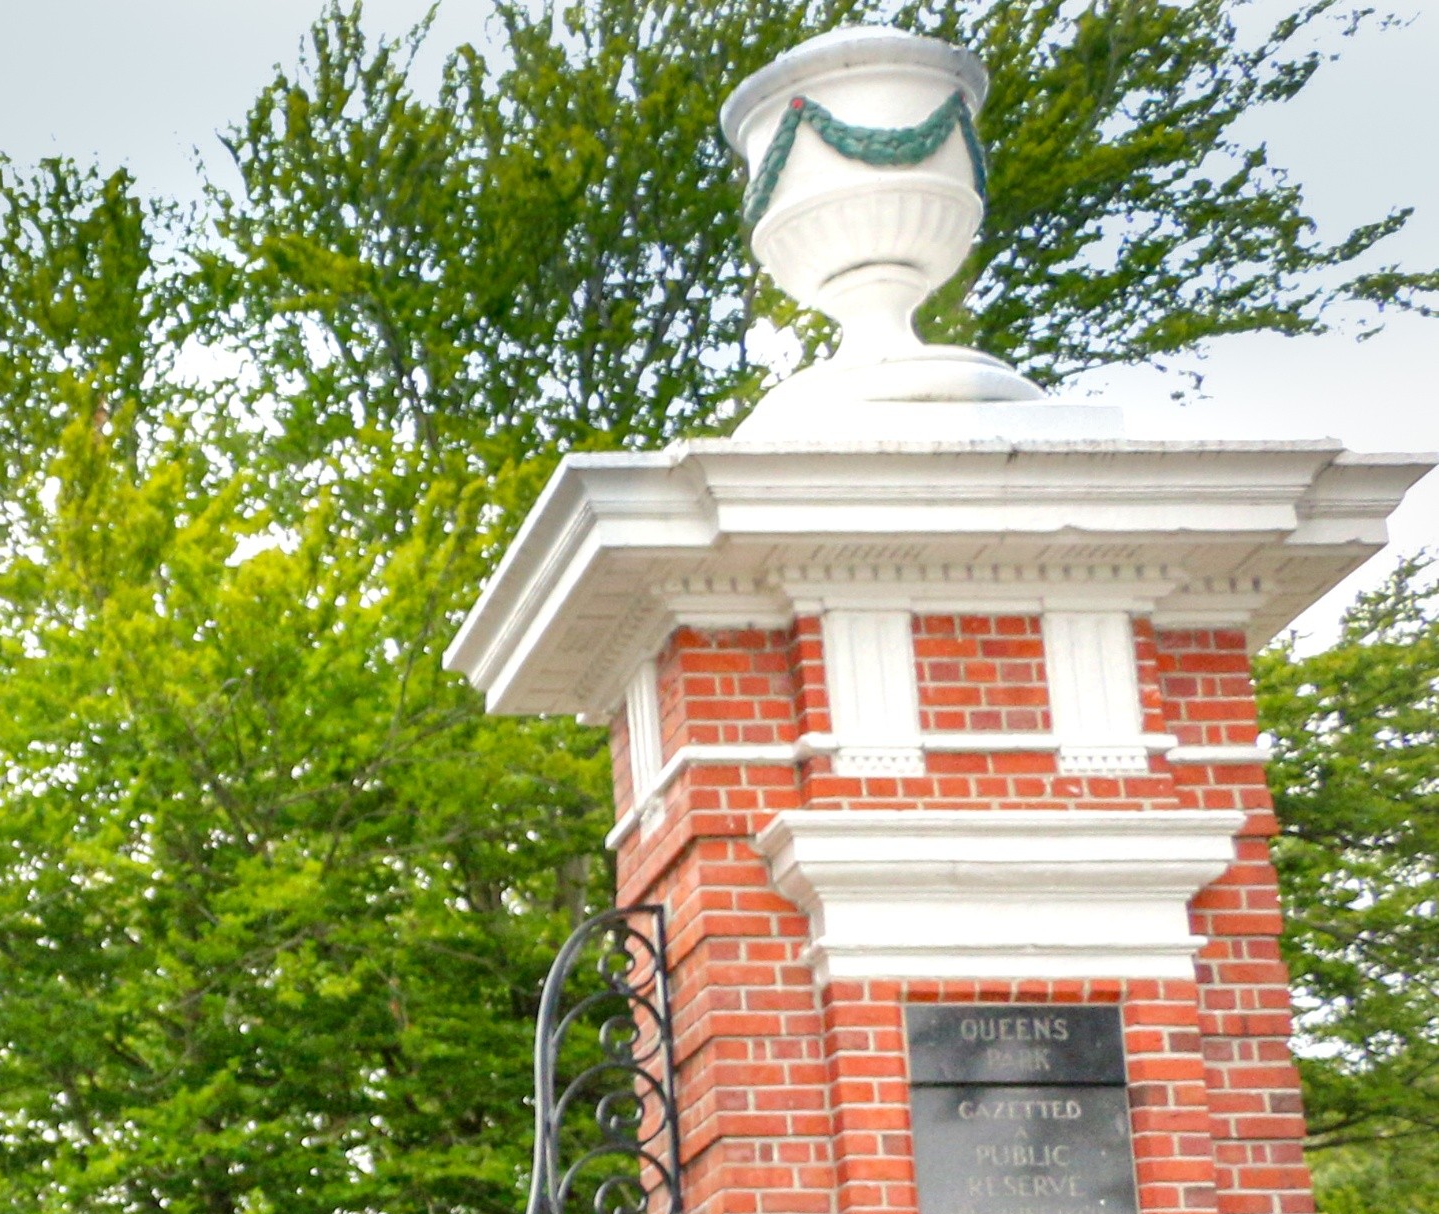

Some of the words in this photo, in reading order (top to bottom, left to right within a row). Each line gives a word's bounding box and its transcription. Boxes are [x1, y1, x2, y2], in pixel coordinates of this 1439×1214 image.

[960, 1018, 1069, 1042] QUEENS
[986, 1048, 1051, 1071] PARK
[958, 1100, 1082, 1120] GAZETTED
[1014, 1126, 1028, 1139] A
[975, 1145, 1071, 1167] PUBLIC
[968, 1175, 1087, 1198] RESERVE
